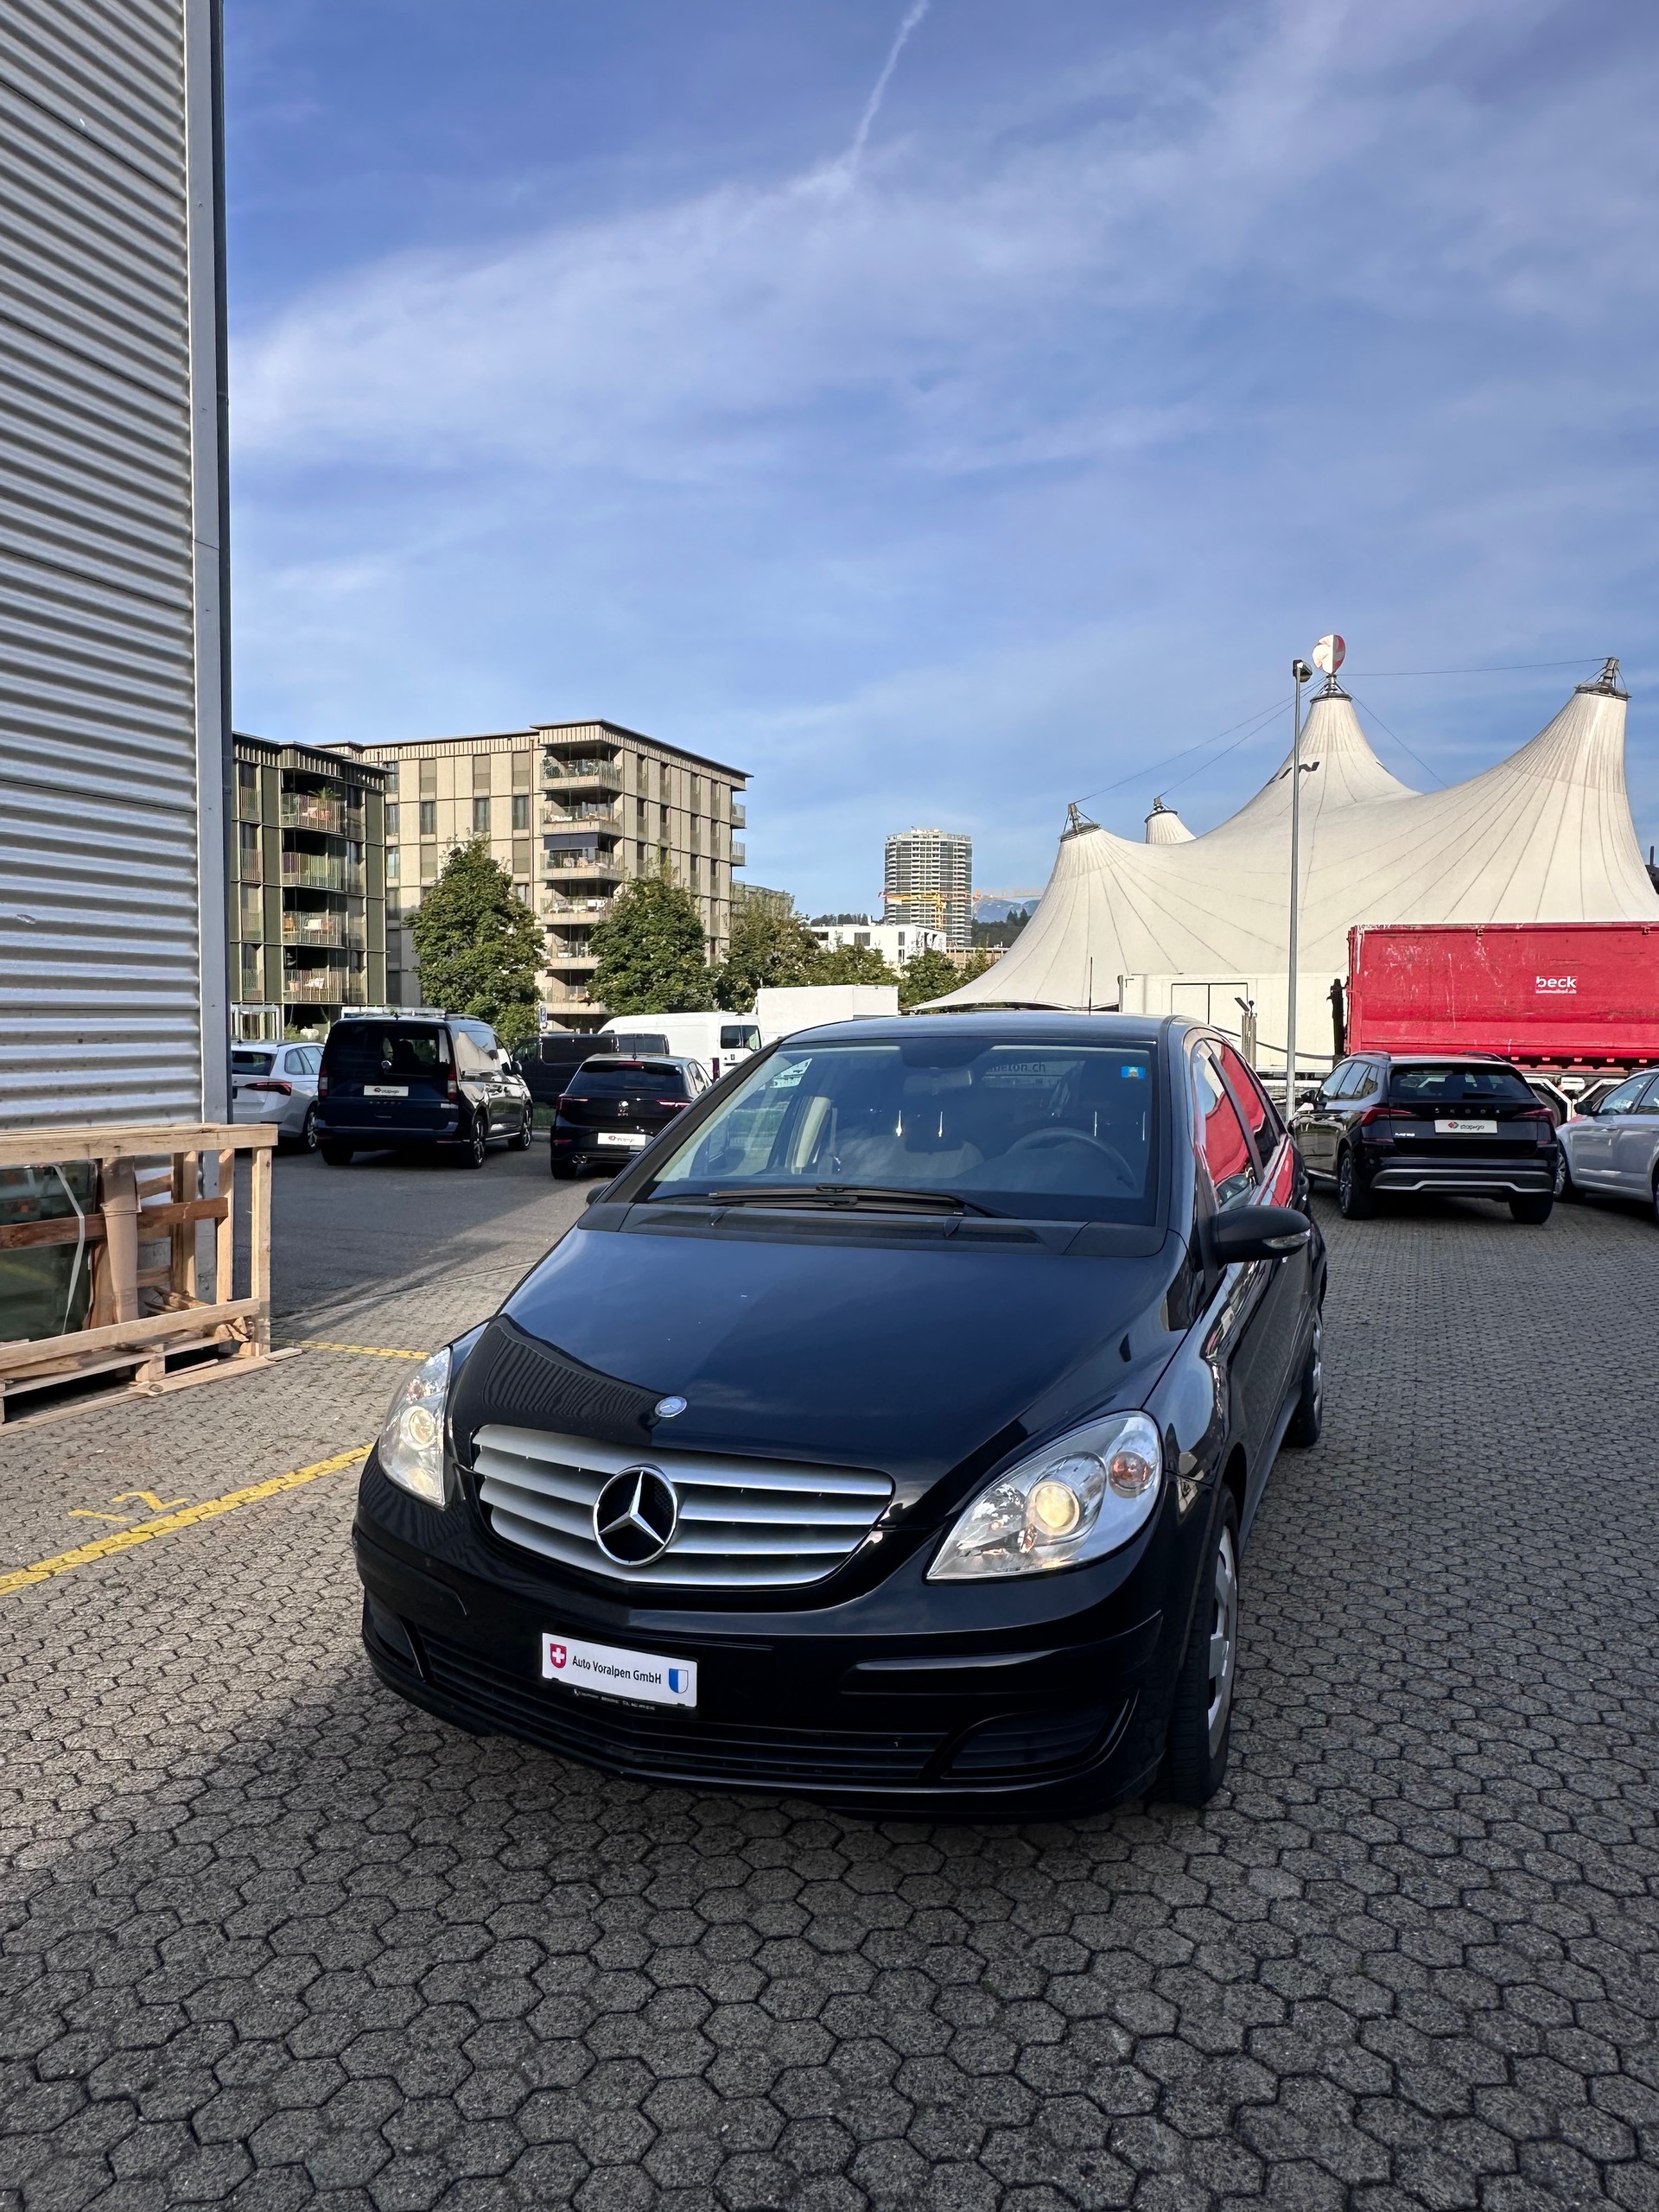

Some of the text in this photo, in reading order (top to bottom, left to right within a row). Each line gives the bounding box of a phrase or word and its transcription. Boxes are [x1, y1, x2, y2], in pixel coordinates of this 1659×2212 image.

[1535, 976, 1578, 988] beck
[572, 1656, 662, 1684] Auto Voralpen GmbH
